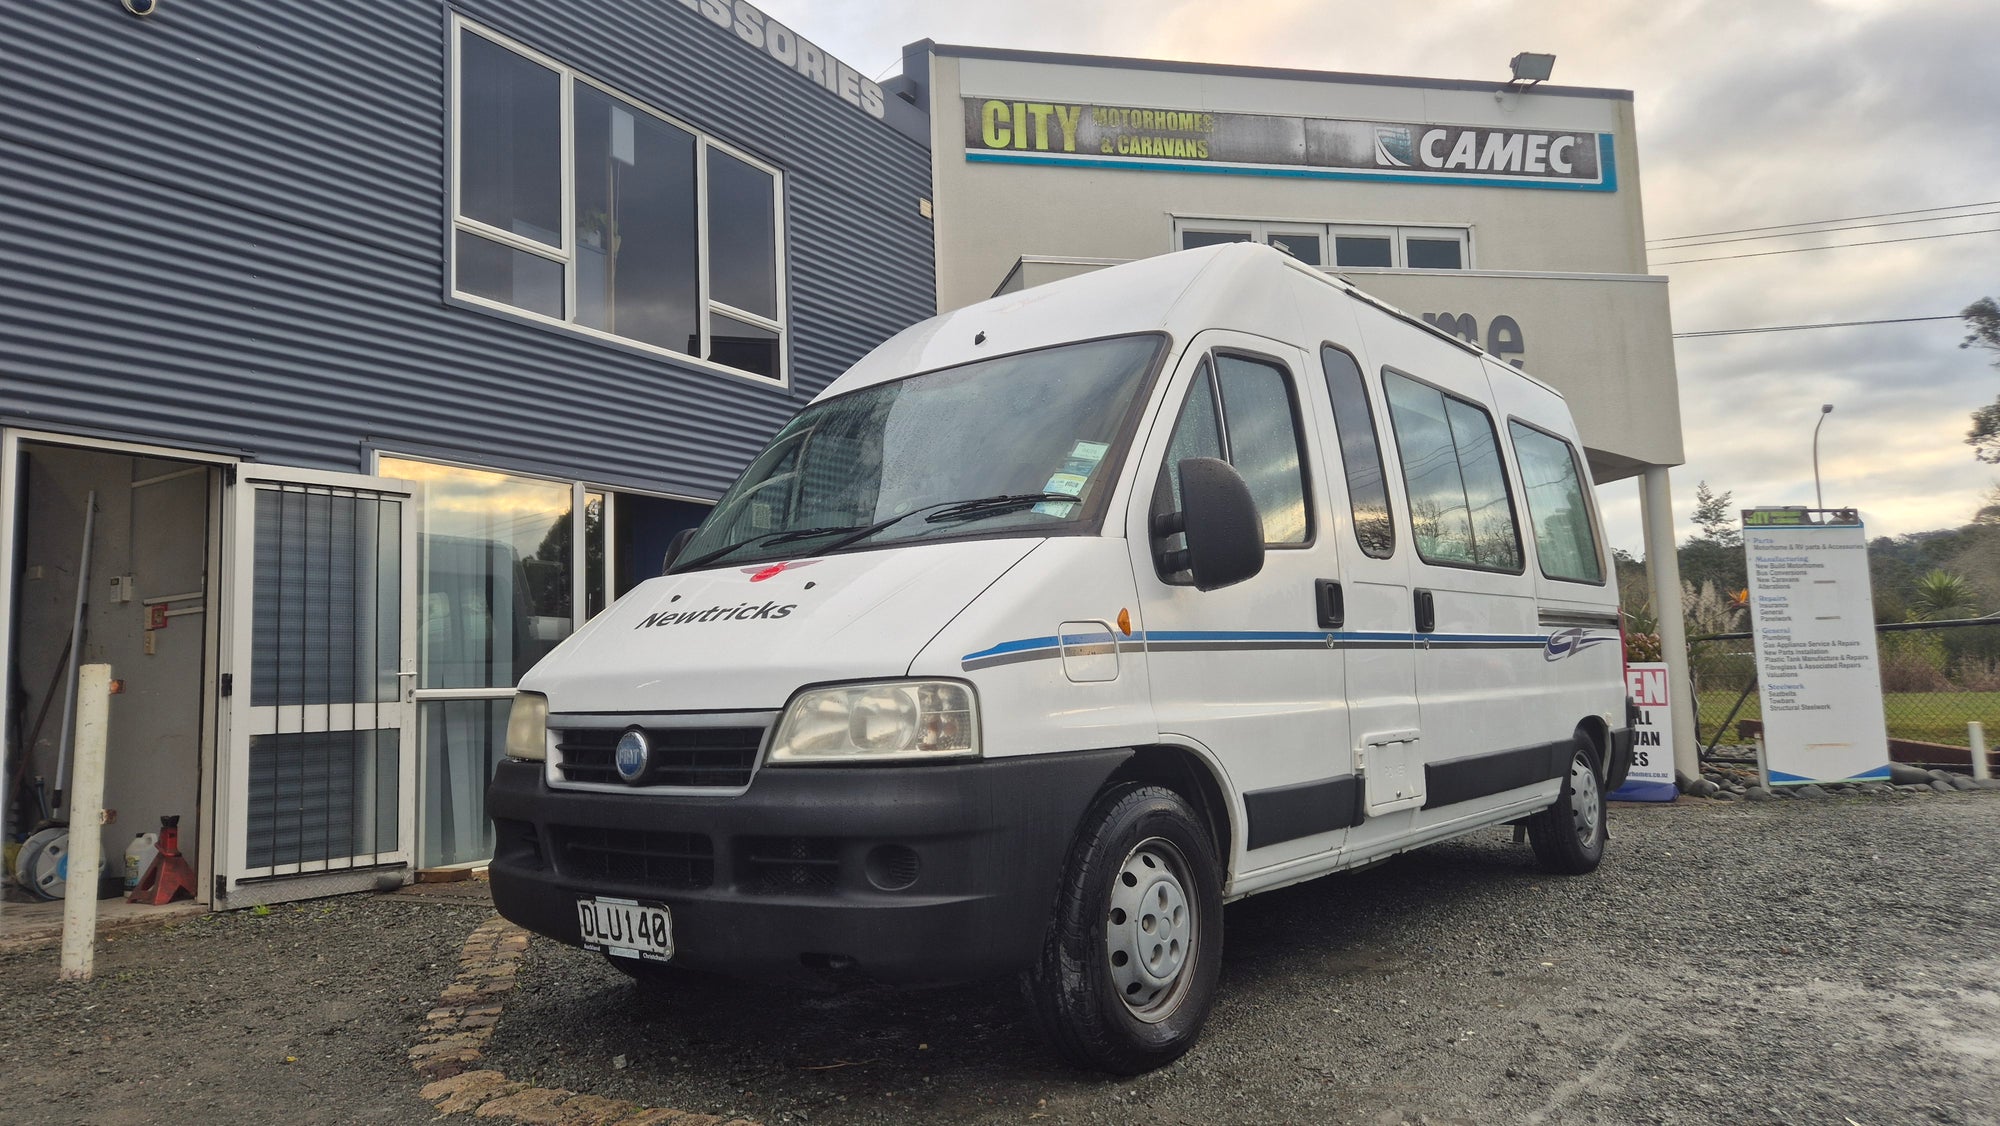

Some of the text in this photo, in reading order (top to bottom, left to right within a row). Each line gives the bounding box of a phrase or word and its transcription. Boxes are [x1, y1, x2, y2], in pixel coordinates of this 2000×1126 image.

[981, 100, 1082, 152] CITY
[1091, 105, 1214, 133] MOTORHOMES
[1101, 136, 1209, 159] & CARAVANS
[1419, 129, 1575, 174] CAMEC
[635, 600, 798, 631] Newtricks
[618, 748, 640, 765] FIAT
[580, 904, 668, 948] DLU140
